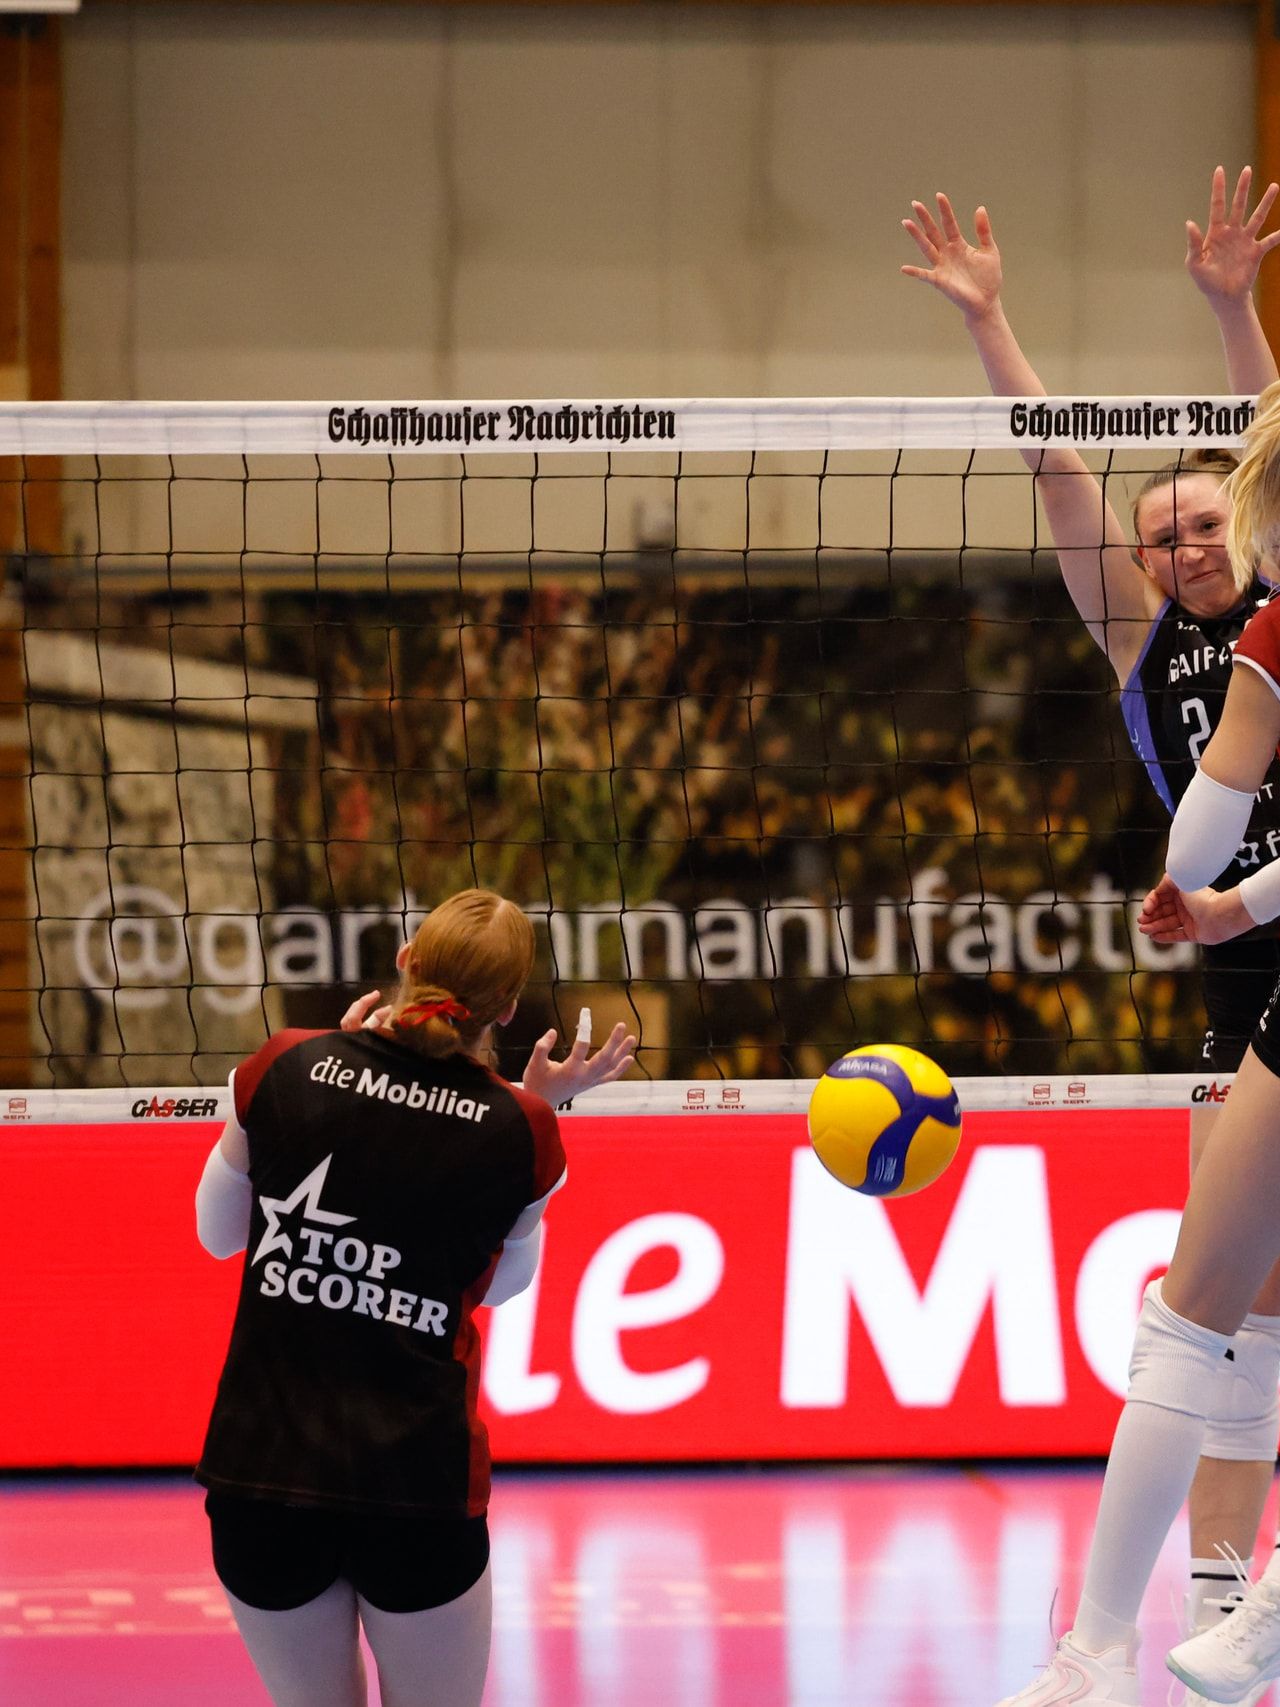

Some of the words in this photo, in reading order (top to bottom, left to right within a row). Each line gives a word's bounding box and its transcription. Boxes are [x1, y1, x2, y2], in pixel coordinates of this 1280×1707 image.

[328, 406, 500, 446] Schaffhauser
[507, 404, 676, 444] Nachrichten
[1010, 401, 1180, 441] Schaffhauser
[131, 1095, 219, 1118] GASSER
[310, 1056, 355, 1088] die
[355, 1067, 490, 1123] Mobiliar
[300, 1227, 402, 1280] TOP
[260, 1260, 449, 1337] SCORER
[483, 1211, 726, 1416] ie
